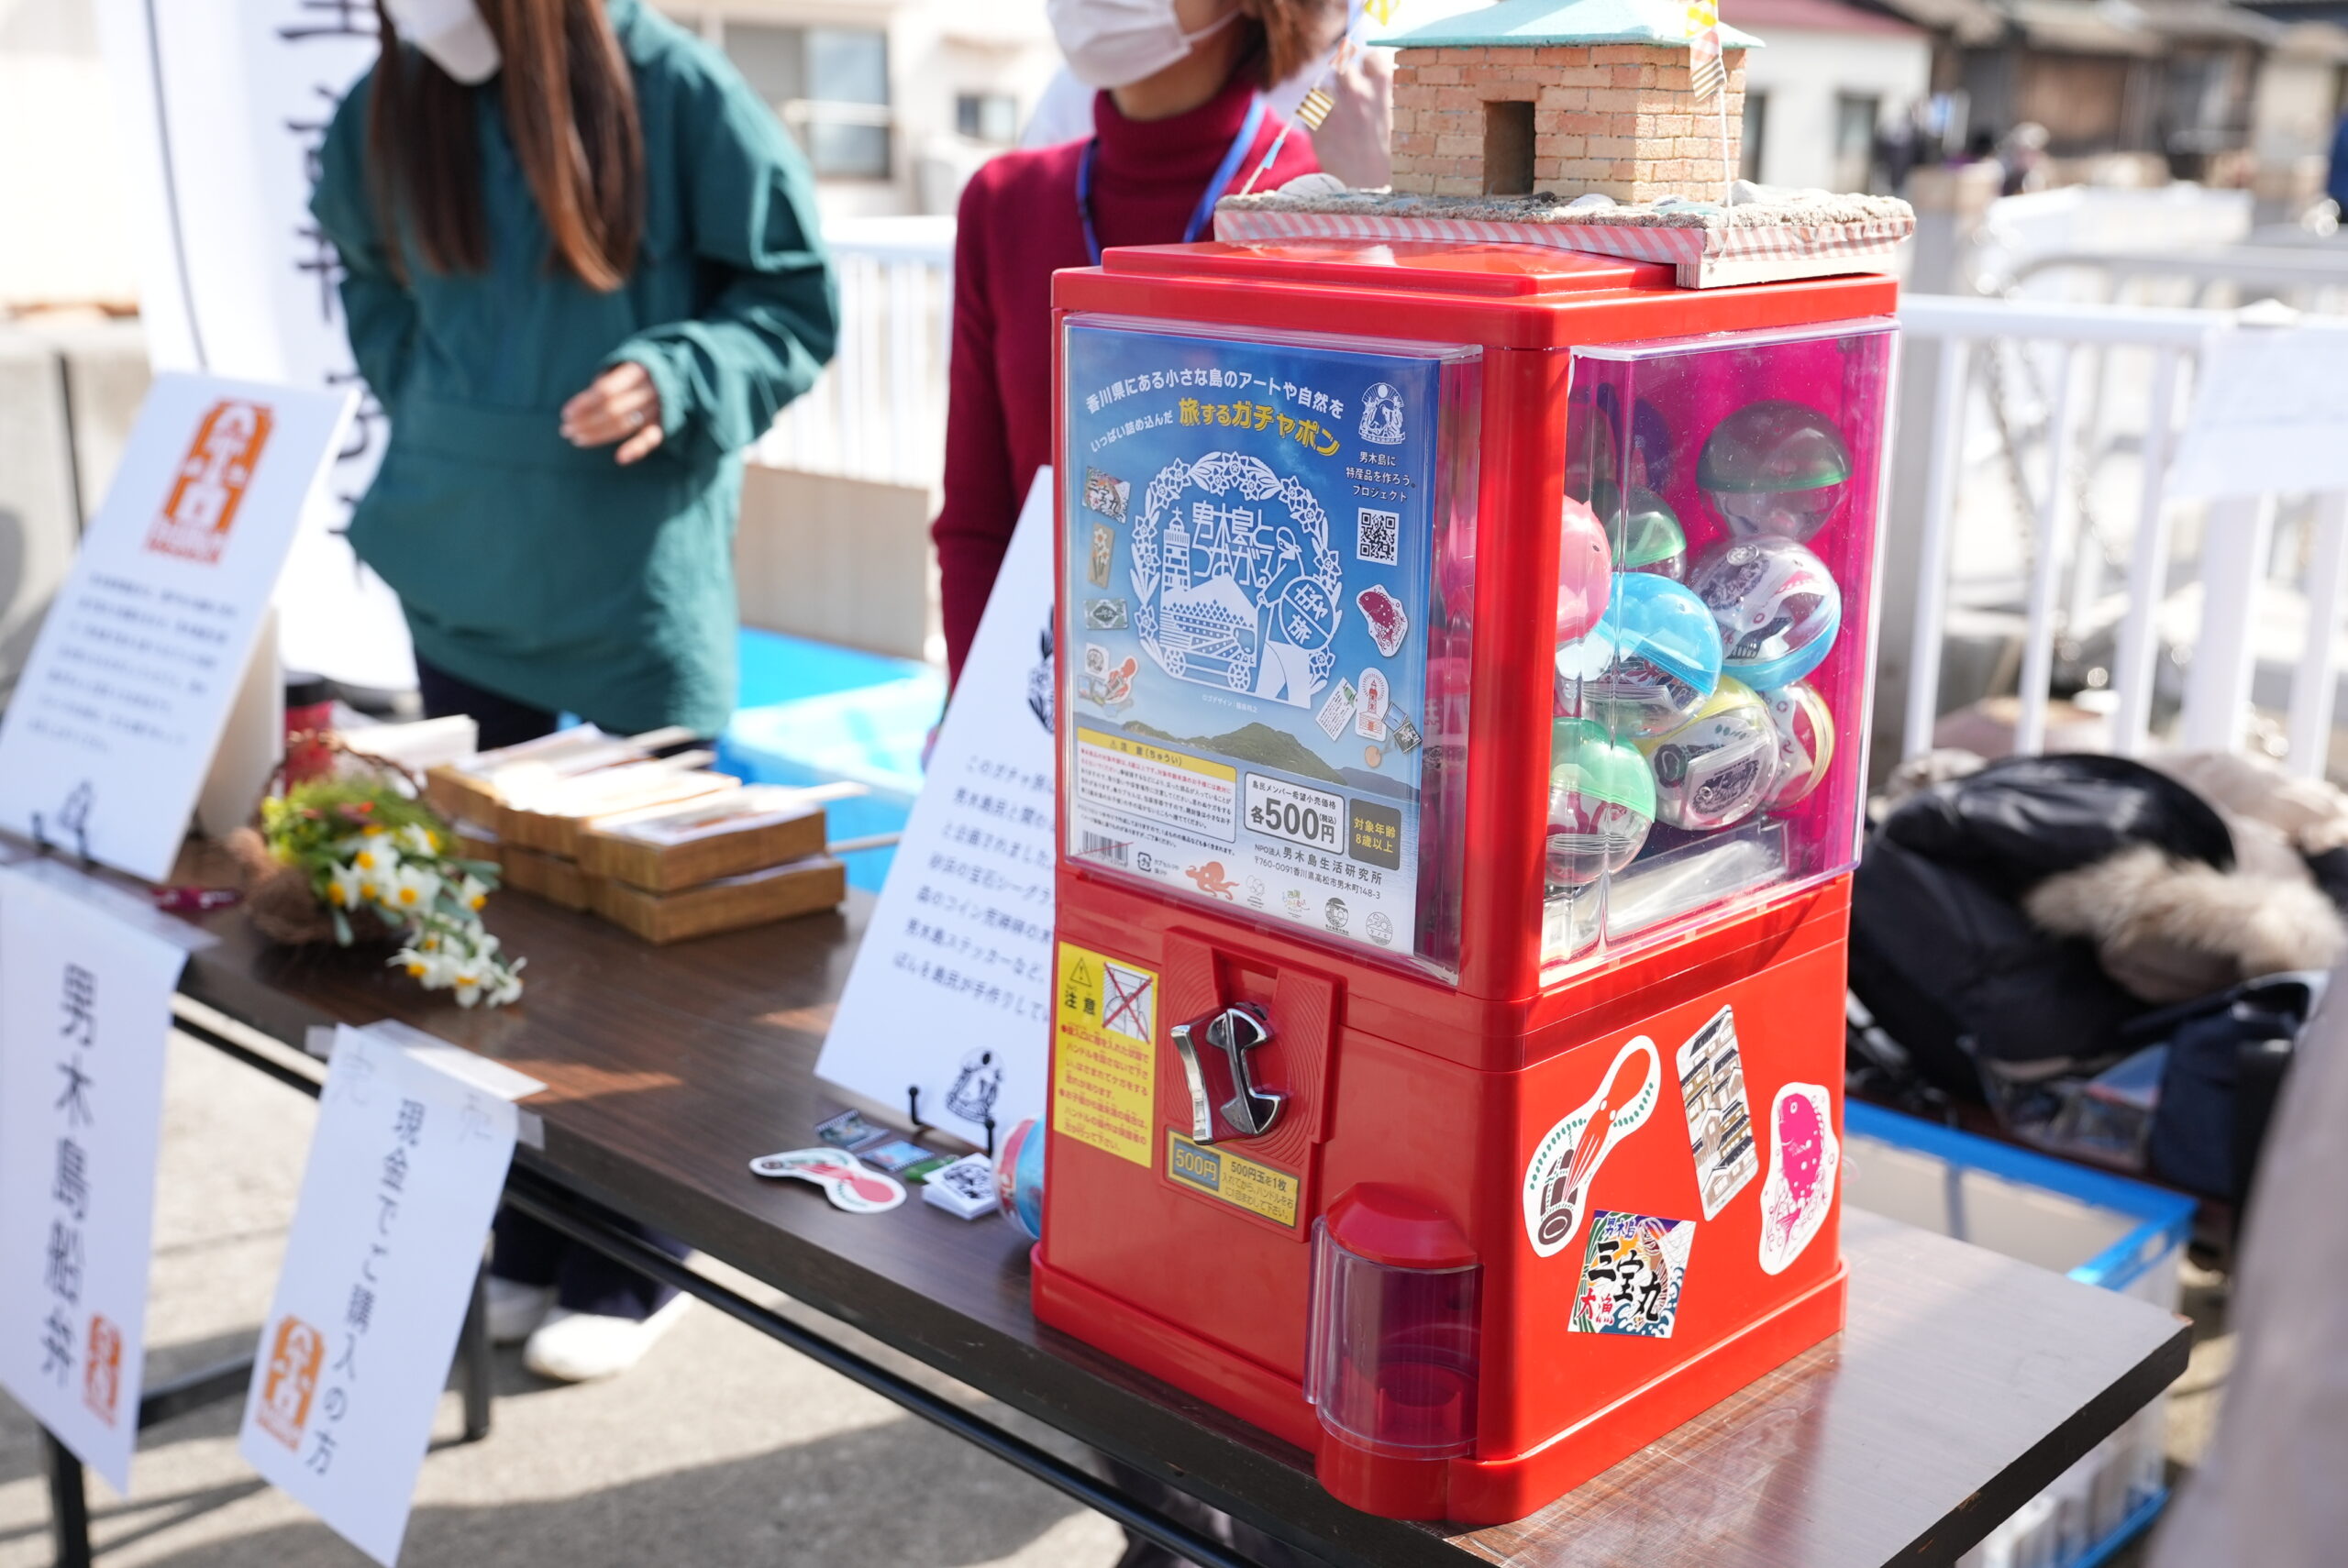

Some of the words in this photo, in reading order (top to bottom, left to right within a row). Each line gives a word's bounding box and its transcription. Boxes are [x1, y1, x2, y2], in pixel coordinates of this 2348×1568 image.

[1086, 368, 1345, 420] 香川県にある小さな島のアートや自然を
[1090, 409, 1174, 453] いっぱい詰め込んだ
[1179, 396, 1341, 457] 旅するガチャポン
[1359, 450, 1397, 468] 男木島に
[1353, 485, 1408, 502] プロジェクト
[1191, 500, 1275, 552] 男木島と
[1287, 613, 1312, 646] 旅
[1252, 780, 1336, 811] 島民メンバー希望小売価格
[1354, 816, 1396, 839] 対象年齢
[1355, 833, 1394, 855] 8歳以上
[1175, 1148, 1218, 1182] 500円
[1230, 1160, 1287, 1193] 500円玉を1枚
[1605, 1217, 1636, 1240] 男木島
[1588, 1241, 1662, 1321] 三宝丸
[1577, 1287, 1614, 1324] 大漁
